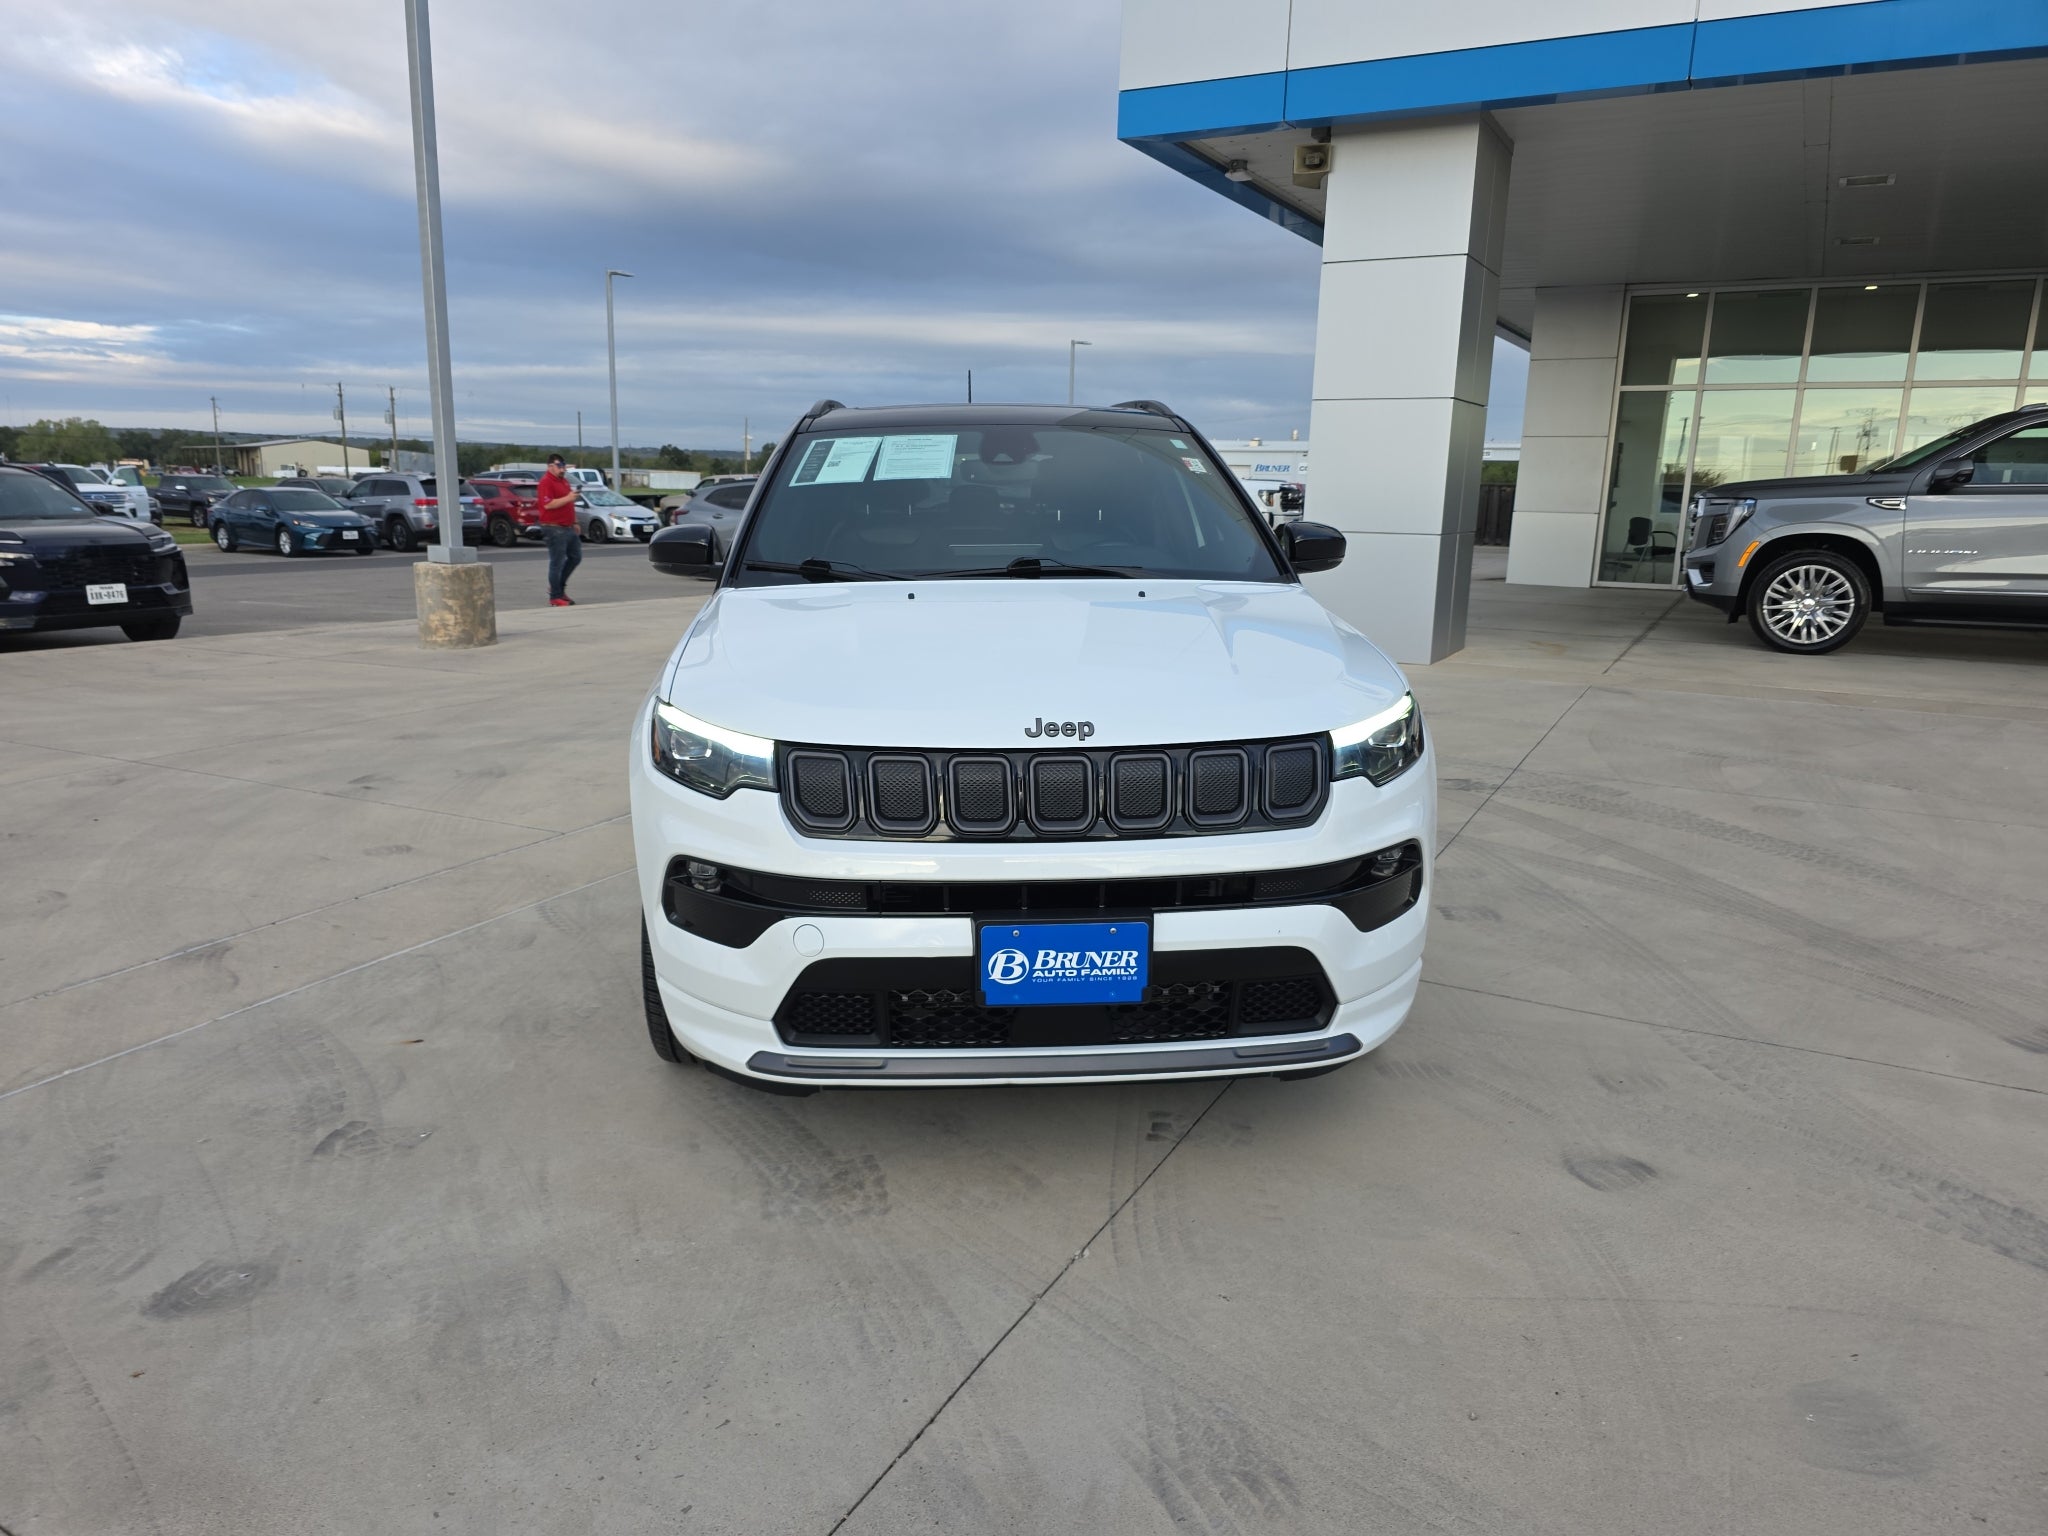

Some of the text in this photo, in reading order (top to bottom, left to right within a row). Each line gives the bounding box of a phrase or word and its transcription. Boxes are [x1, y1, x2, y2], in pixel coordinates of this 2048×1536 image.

[1024, 717, 1095, 741] Jeep
[1033, 950, 1138, 969] BRUNER
[1032, 967, 1138, 978] AUTO FAMILY
